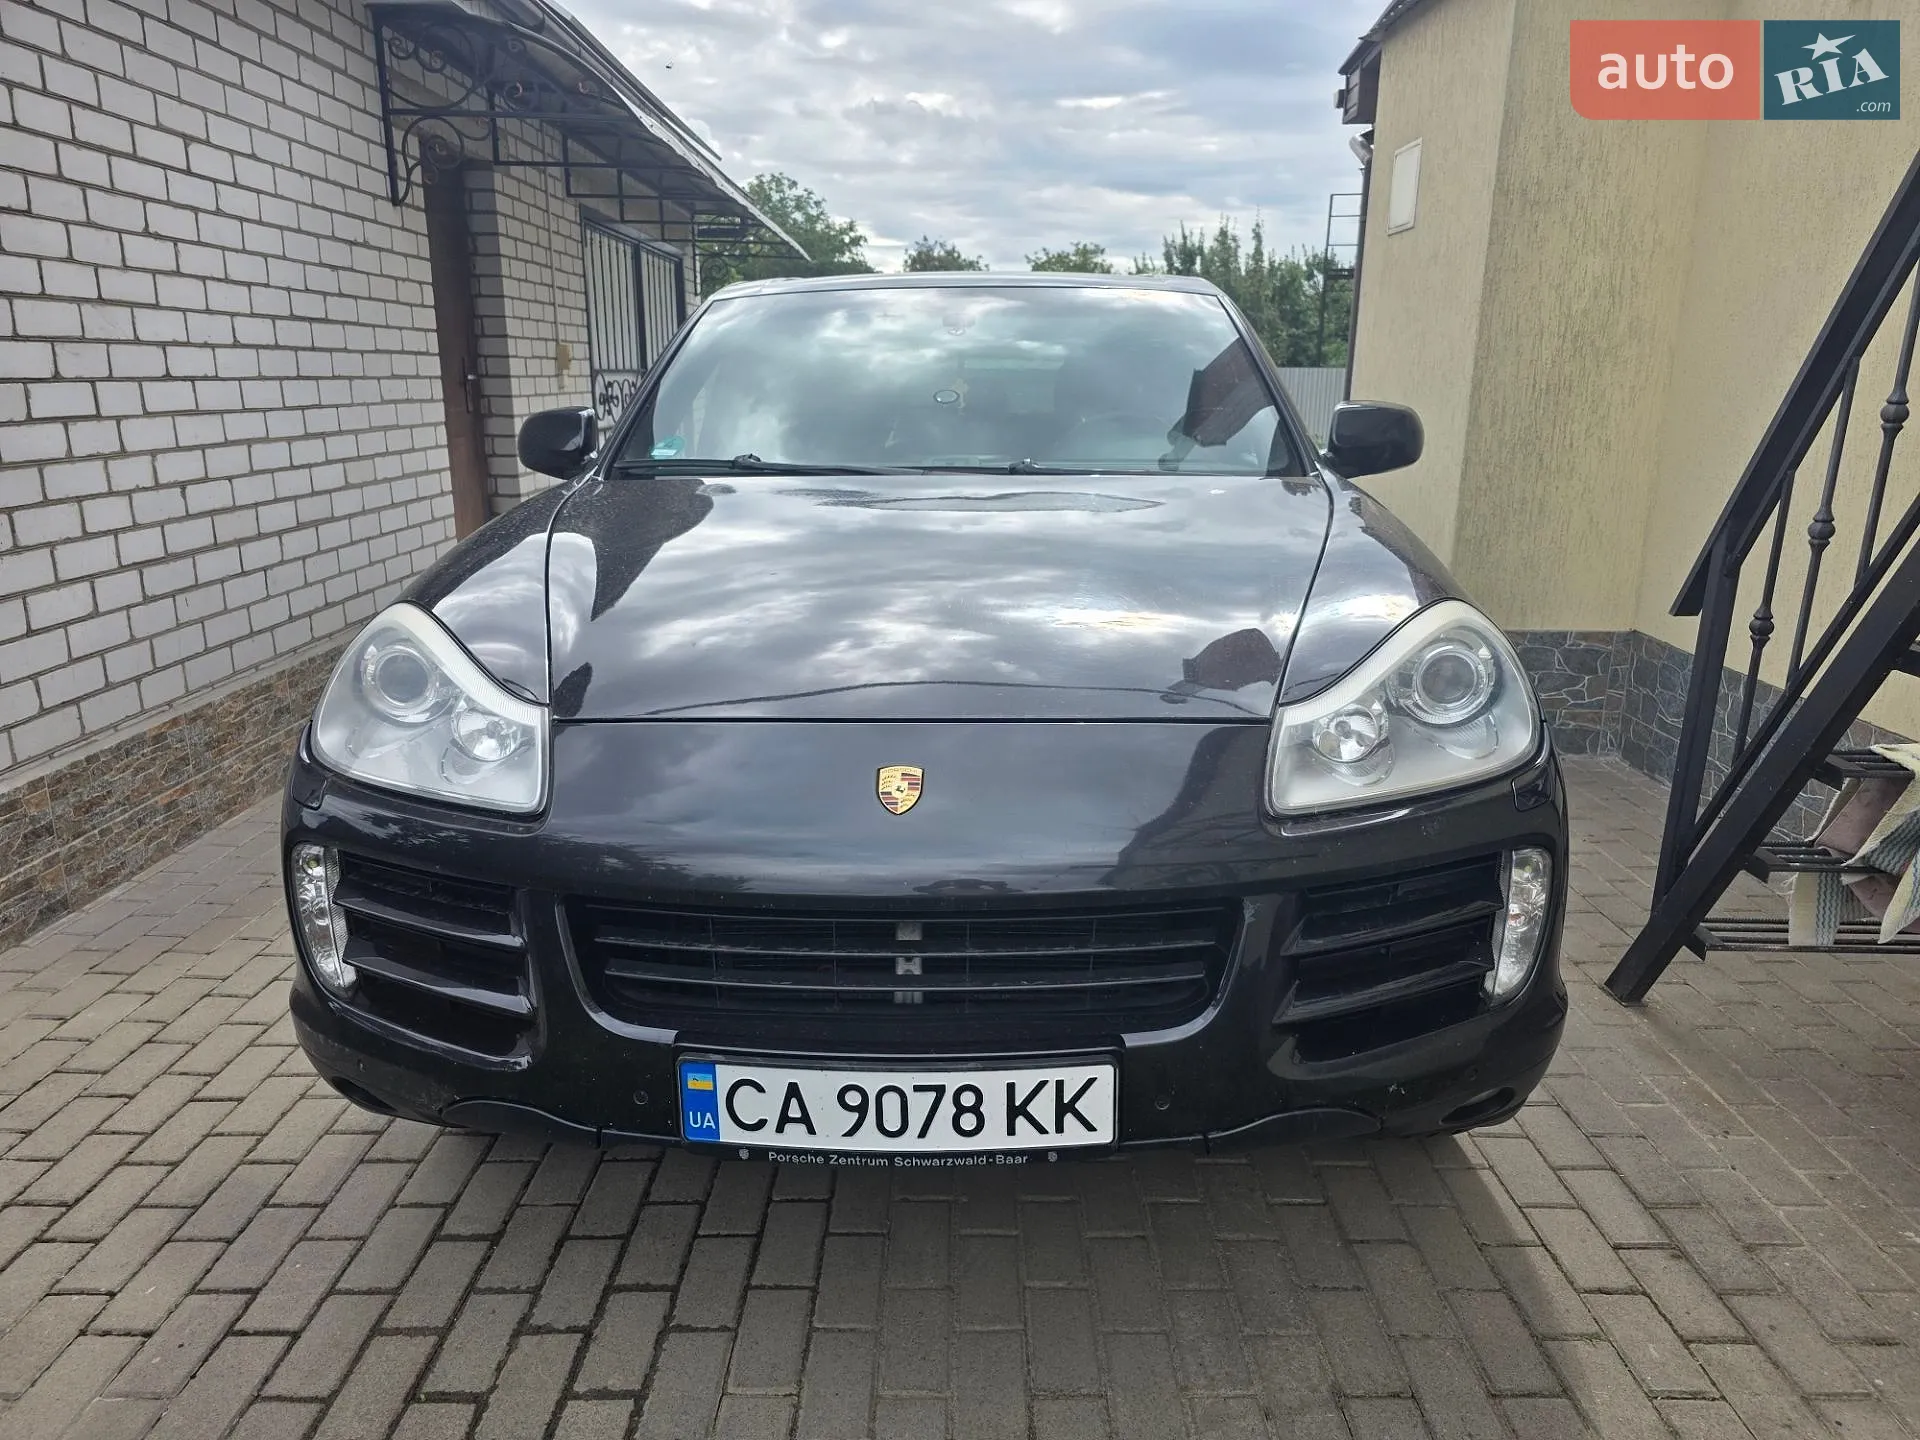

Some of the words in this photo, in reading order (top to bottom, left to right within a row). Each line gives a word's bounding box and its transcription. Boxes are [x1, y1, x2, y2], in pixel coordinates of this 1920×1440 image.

[725, 1078, 816, 1136] CA
[836, 1083, 986, 1139] 9078
[1005, 1077, 1098, 1137] KK
[689, 1111, 716, 1130] UA
[768, 1151, 825, 1165] Porsche
[828, 1154, 889, 1167] Zentrum
[894, 1153, 1029, 1167] Schwarzwald-Baar
